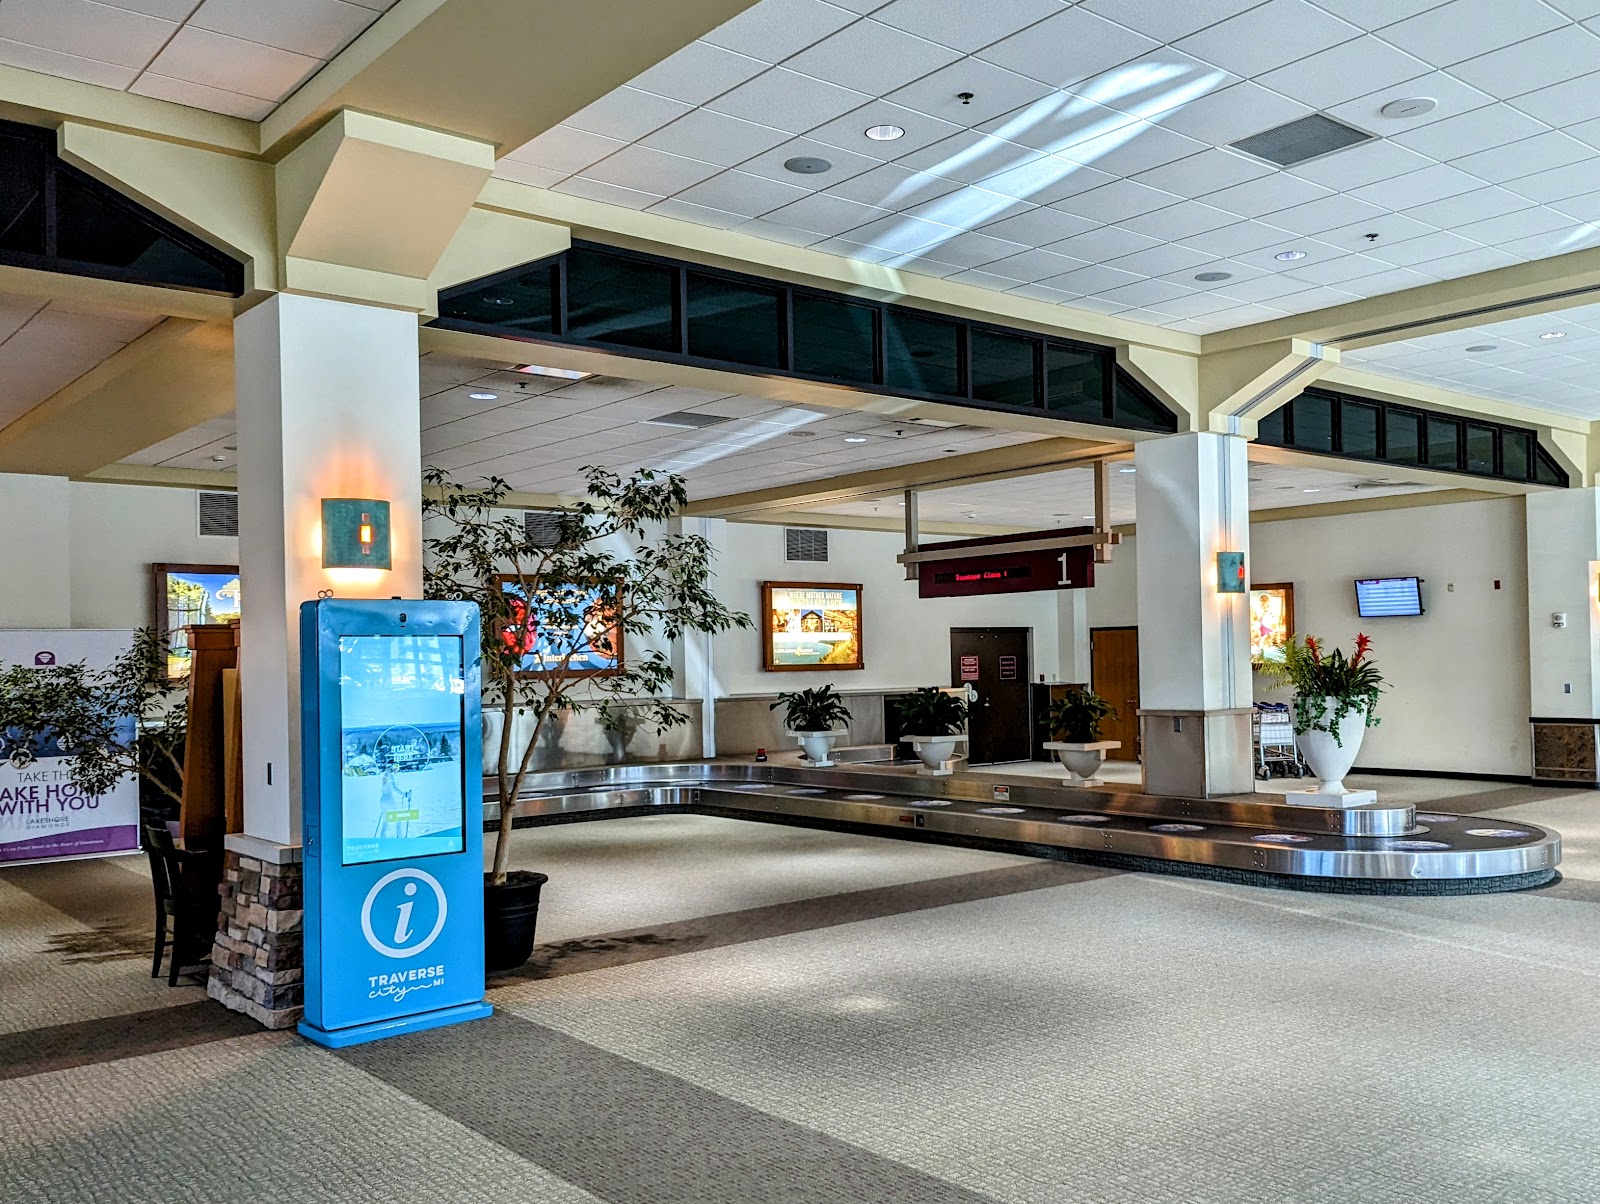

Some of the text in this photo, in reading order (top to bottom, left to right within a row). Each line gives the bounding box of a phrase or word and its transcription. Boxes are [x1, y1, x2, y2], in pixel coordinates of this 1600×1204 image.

[1057, 552, 1072, 586] 1
[789, 591, 843, 600] WHERE MOTHER NATURE
[390, 744, 415, 753] START
[393, 753, 414, 762] HERE
[17, 771, 49, 783] TAKE
[0, 796, 100, 816] WITH YOU
[26, 815, 70, 825] LAKESHORE
[368, 965, 445, 988] TRAVERSE
[368, 978, 445, 1002] city MI
